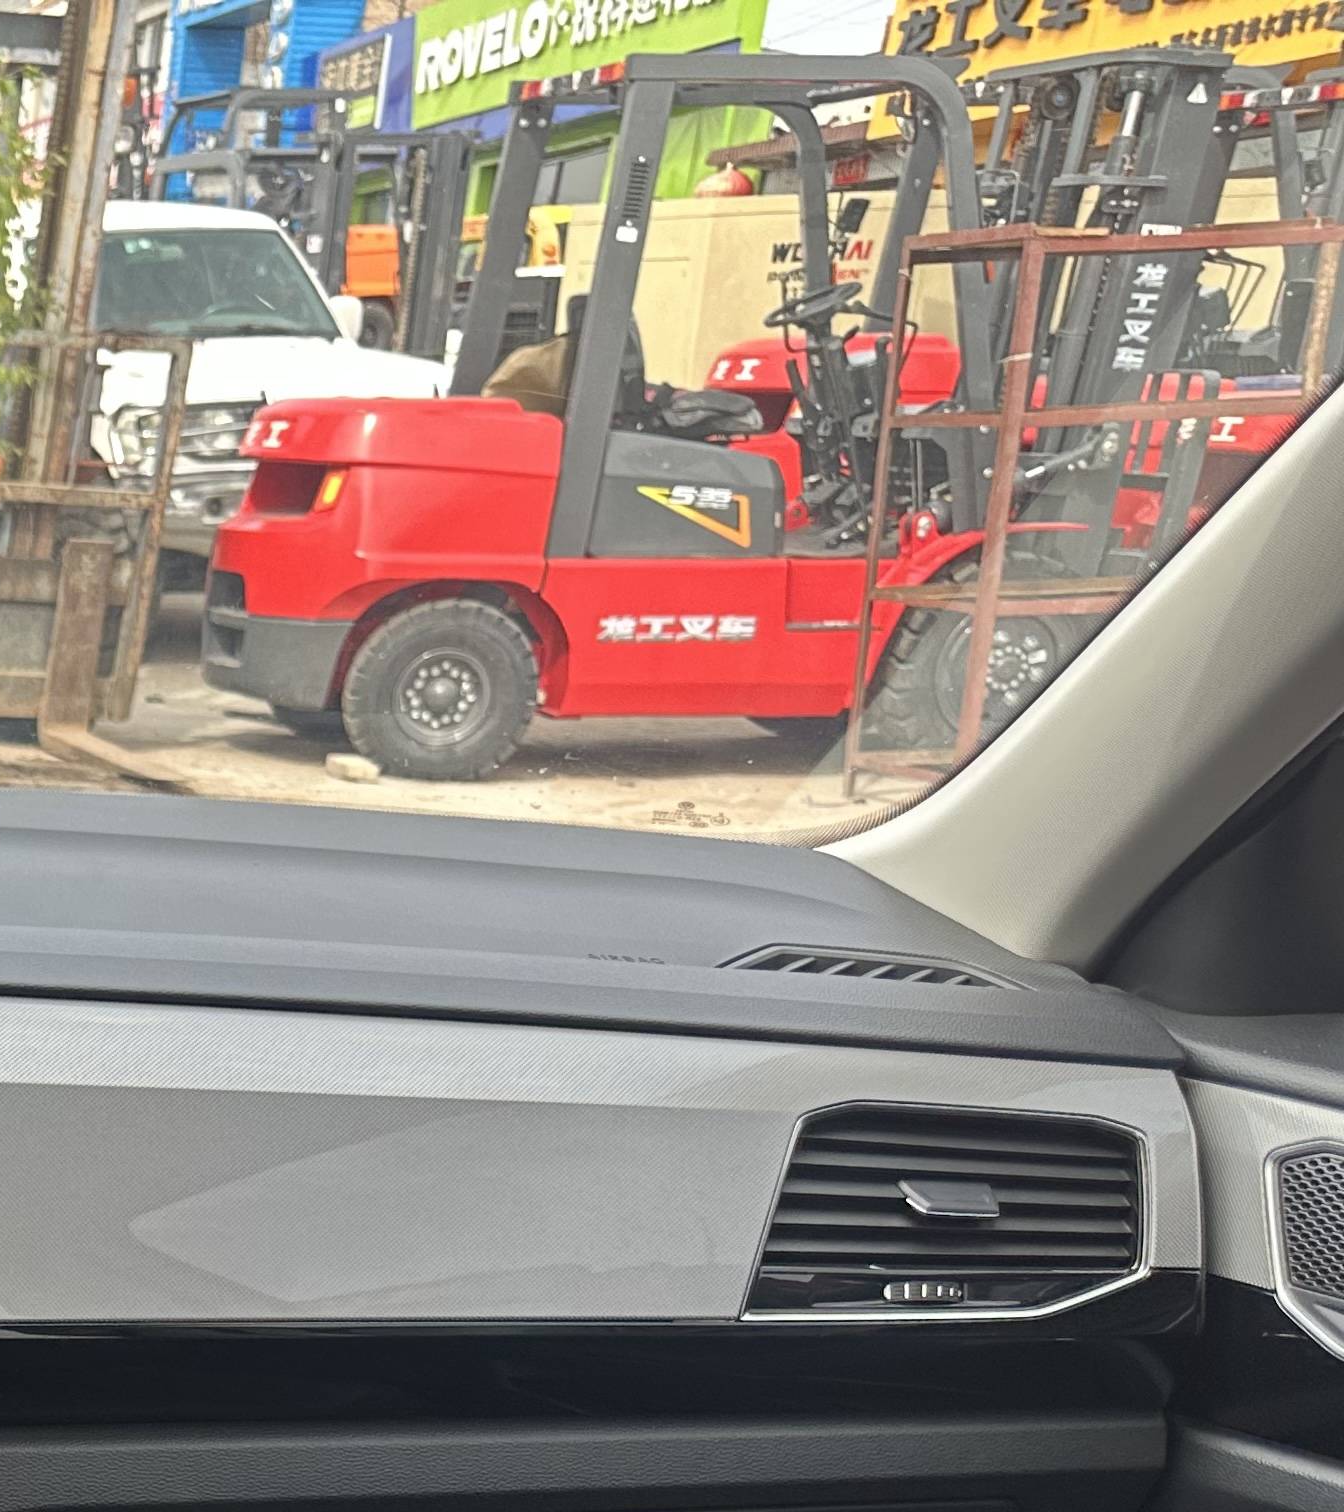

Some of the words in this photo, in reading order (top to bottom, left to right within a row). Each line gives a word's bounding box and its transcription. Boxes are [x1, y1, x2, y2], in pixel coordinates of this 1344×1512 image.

[415, 2, 550, 94] ROVELO
[596, 614, 758, 643] 龙工叉车
